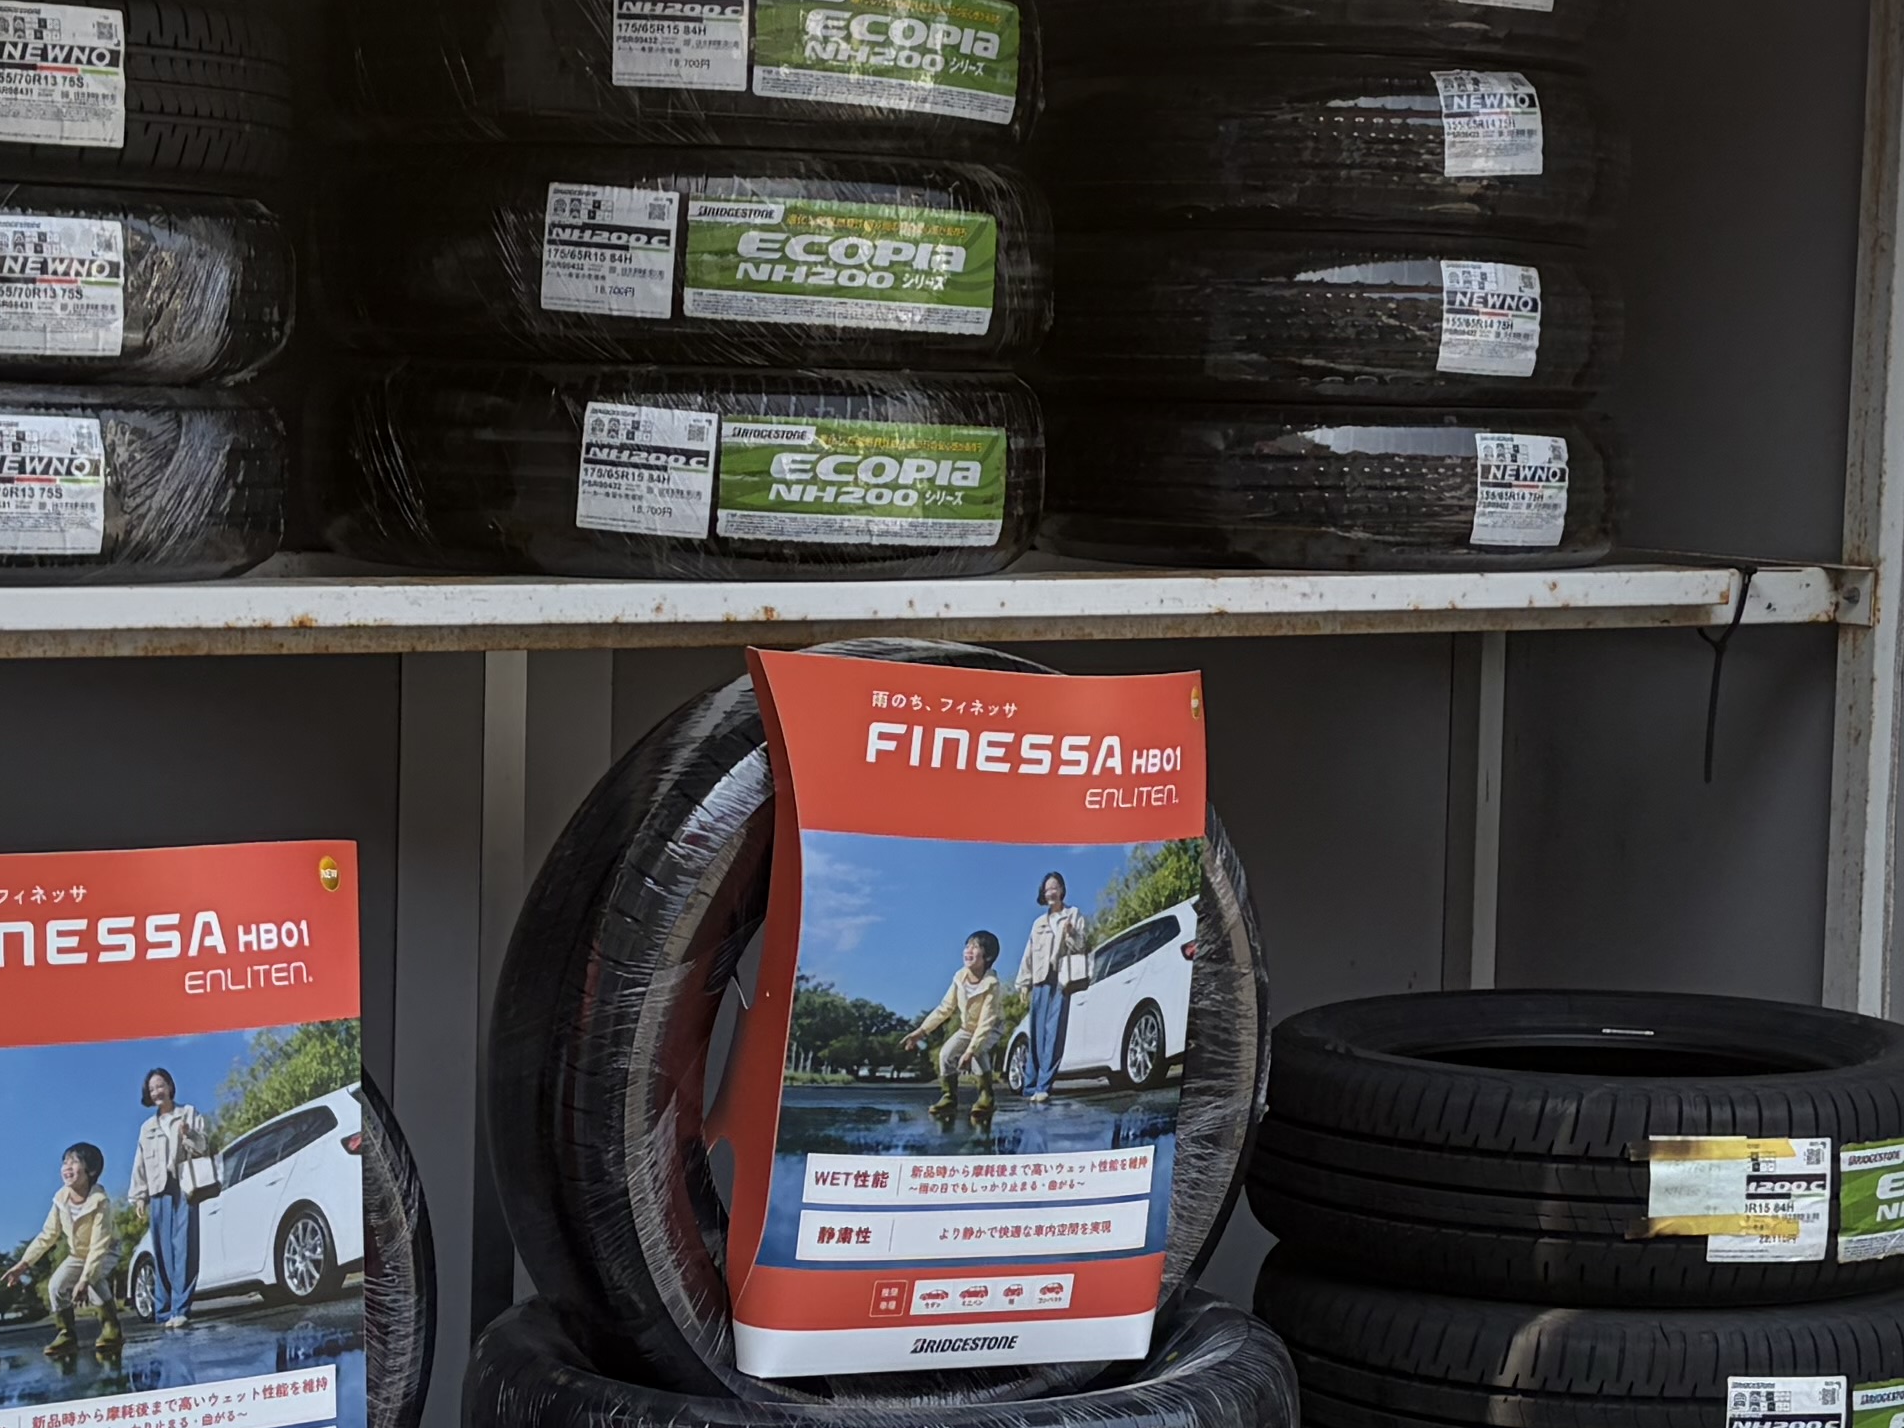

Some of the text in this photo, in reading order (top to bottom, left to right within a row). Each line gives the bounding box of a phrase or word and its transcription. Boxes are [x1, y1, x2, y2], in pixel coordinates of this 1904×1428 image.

[2, 41, 111, 67] NEWNO
[805, 41, 945, 73] NH200
[1454, 94, 1529, 109] NEWNO
[2, 255, 110, 278] NEWNO
[736, 263, 895, 289] NH200
[1455, 292, 1533, 311] NEWNO
[1489, 465, 1560, 481] NEWNO
[768, 483, 918, 507] NH200
[872, 690, 1018, 718] 雨のち、フィネッサ
[866, 722, 1181, 776] FINESSA HB01
[237, 919, 310, 953] HB01
[815, 1170, 889, 1189] WET性能
[910, 1336, 1019, 1354] BRIDGESTONE
